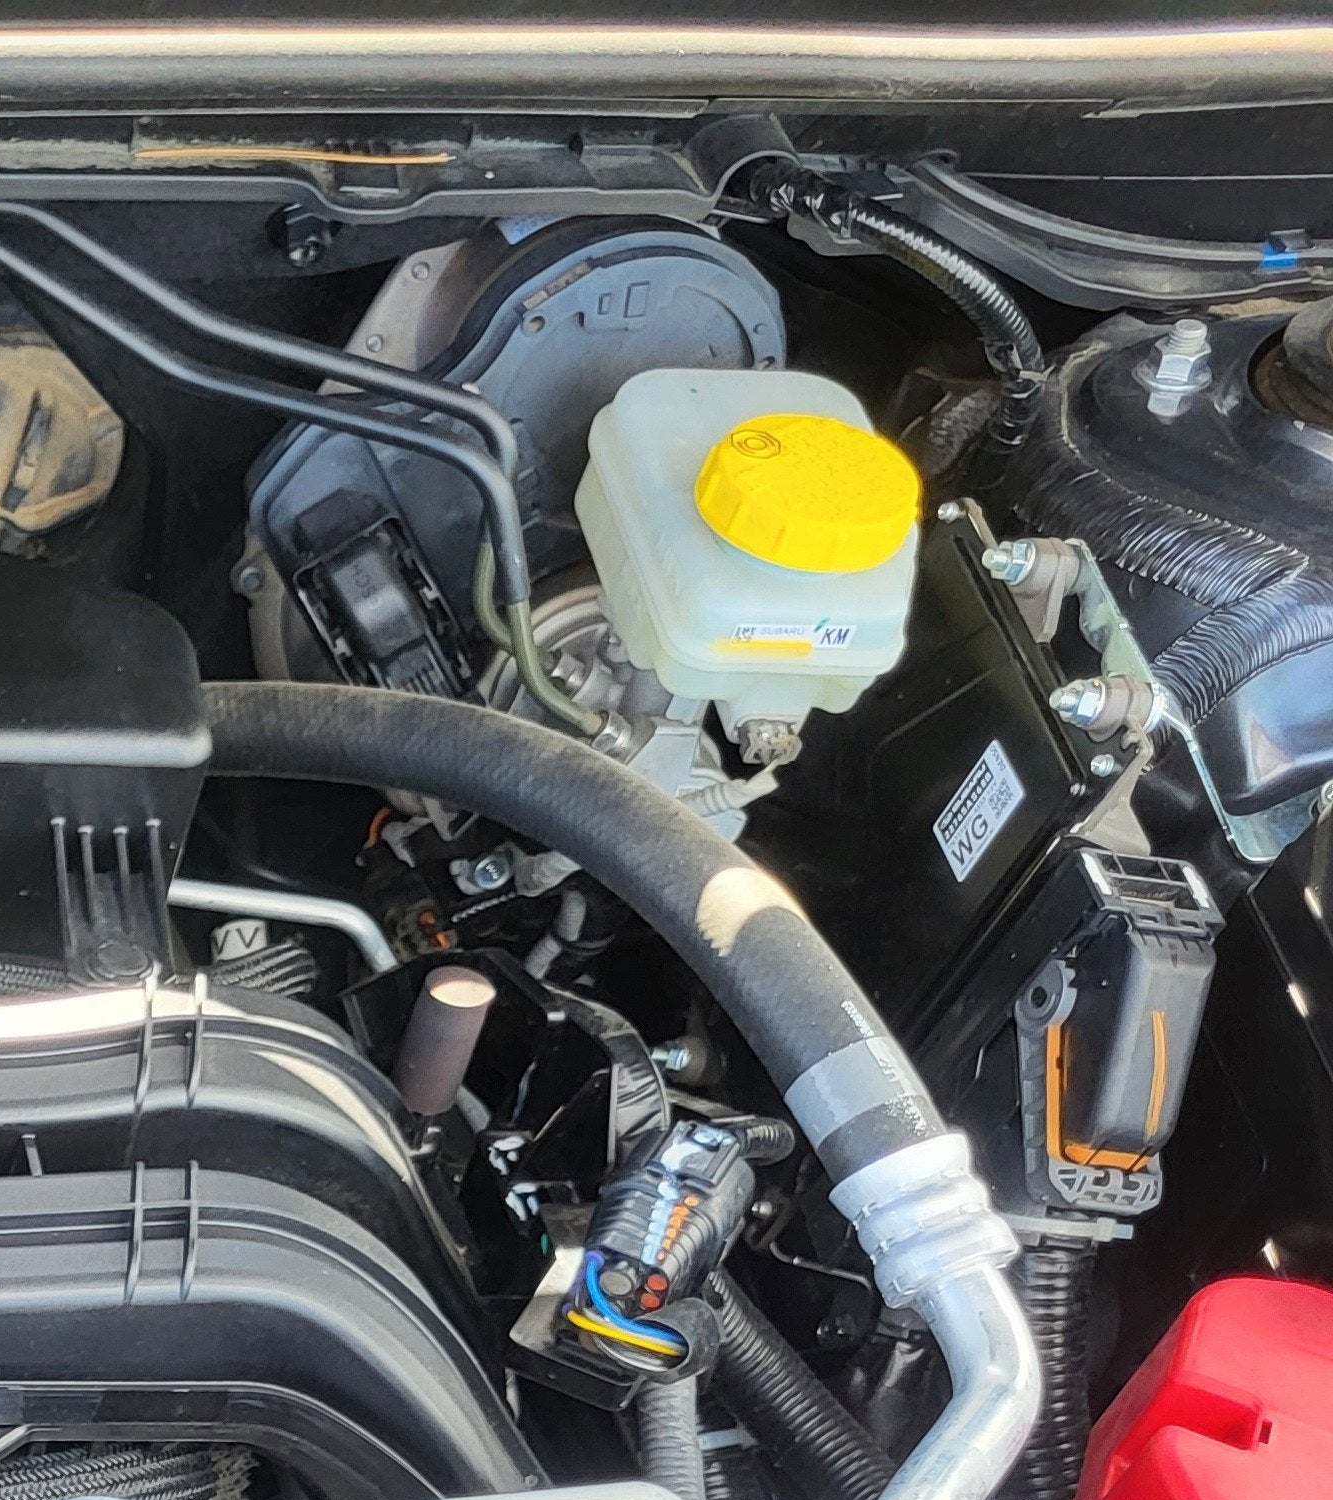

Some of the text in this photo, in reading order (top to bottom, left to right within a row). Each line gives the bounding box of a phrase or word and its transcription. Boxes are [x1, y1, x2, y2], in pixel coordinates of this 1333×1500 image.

[760, 627, 850, 645] SUBARU KM
[950, 814, 989, 866] WG
